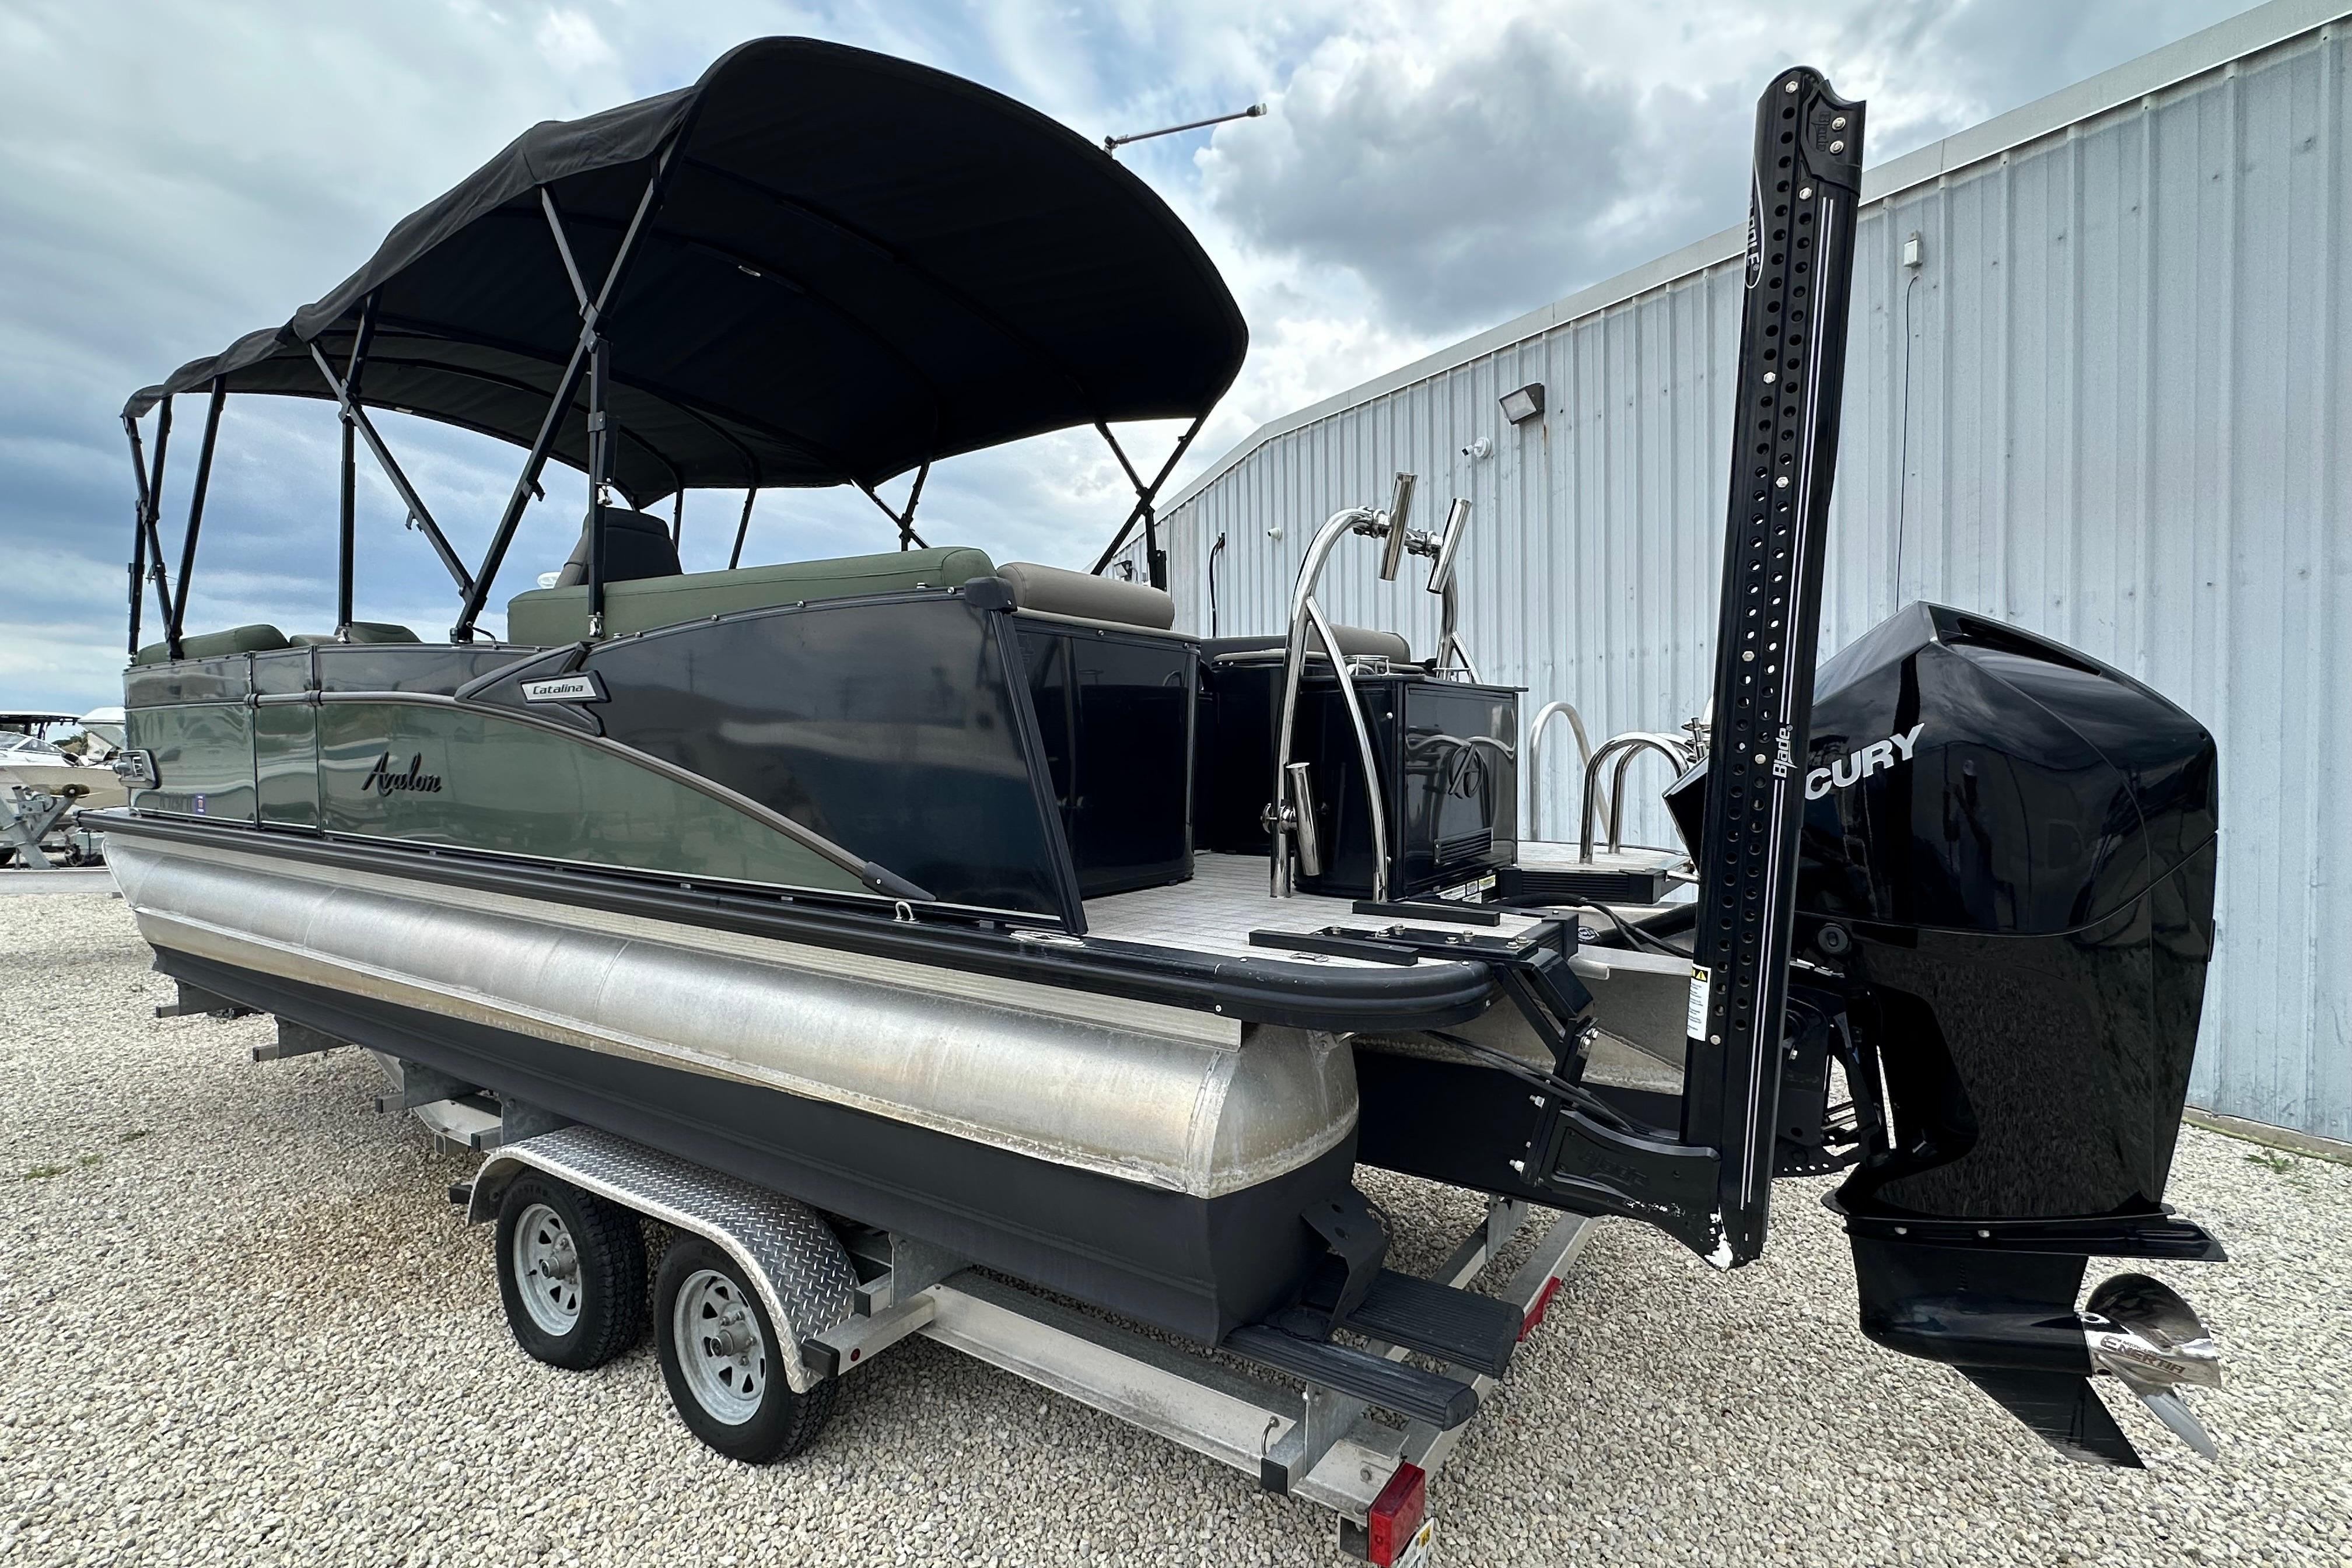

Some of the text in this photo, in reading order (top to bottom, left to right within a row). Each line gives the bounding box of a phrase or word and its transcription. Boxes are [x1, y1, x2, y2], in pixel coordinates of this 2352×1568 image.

[533, 684, 583, 694] Catalina
[361, 751, 442, 797] Avalon
[1772, 727, 1798, 778] Blade
